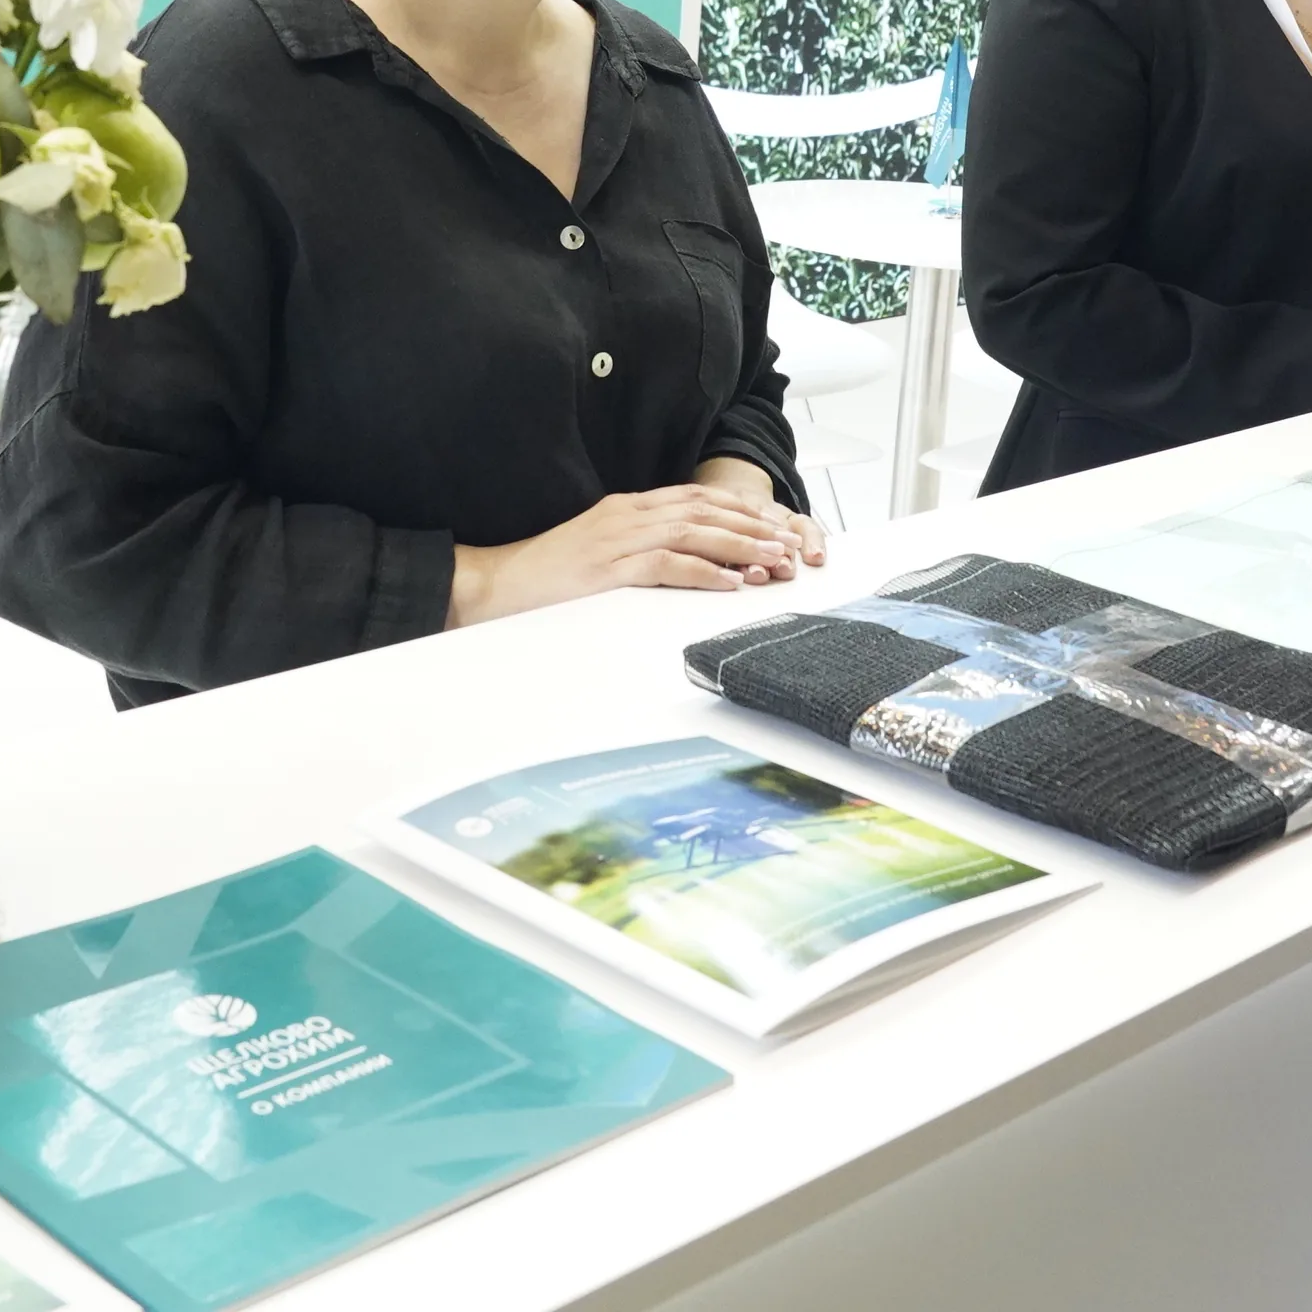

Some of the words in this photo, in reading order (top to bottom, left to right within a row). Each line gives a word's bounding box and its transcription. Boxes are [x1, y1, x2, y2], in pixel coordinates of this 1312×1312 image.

[186, 1015, 332, 1076] ЩЕЛКОВО
[212, 1026, 355, 1091] АГРОХИМ
[251, 1100, 274, 1116] О
[272, 1053, 394, 1108] КОМПАНИИ
